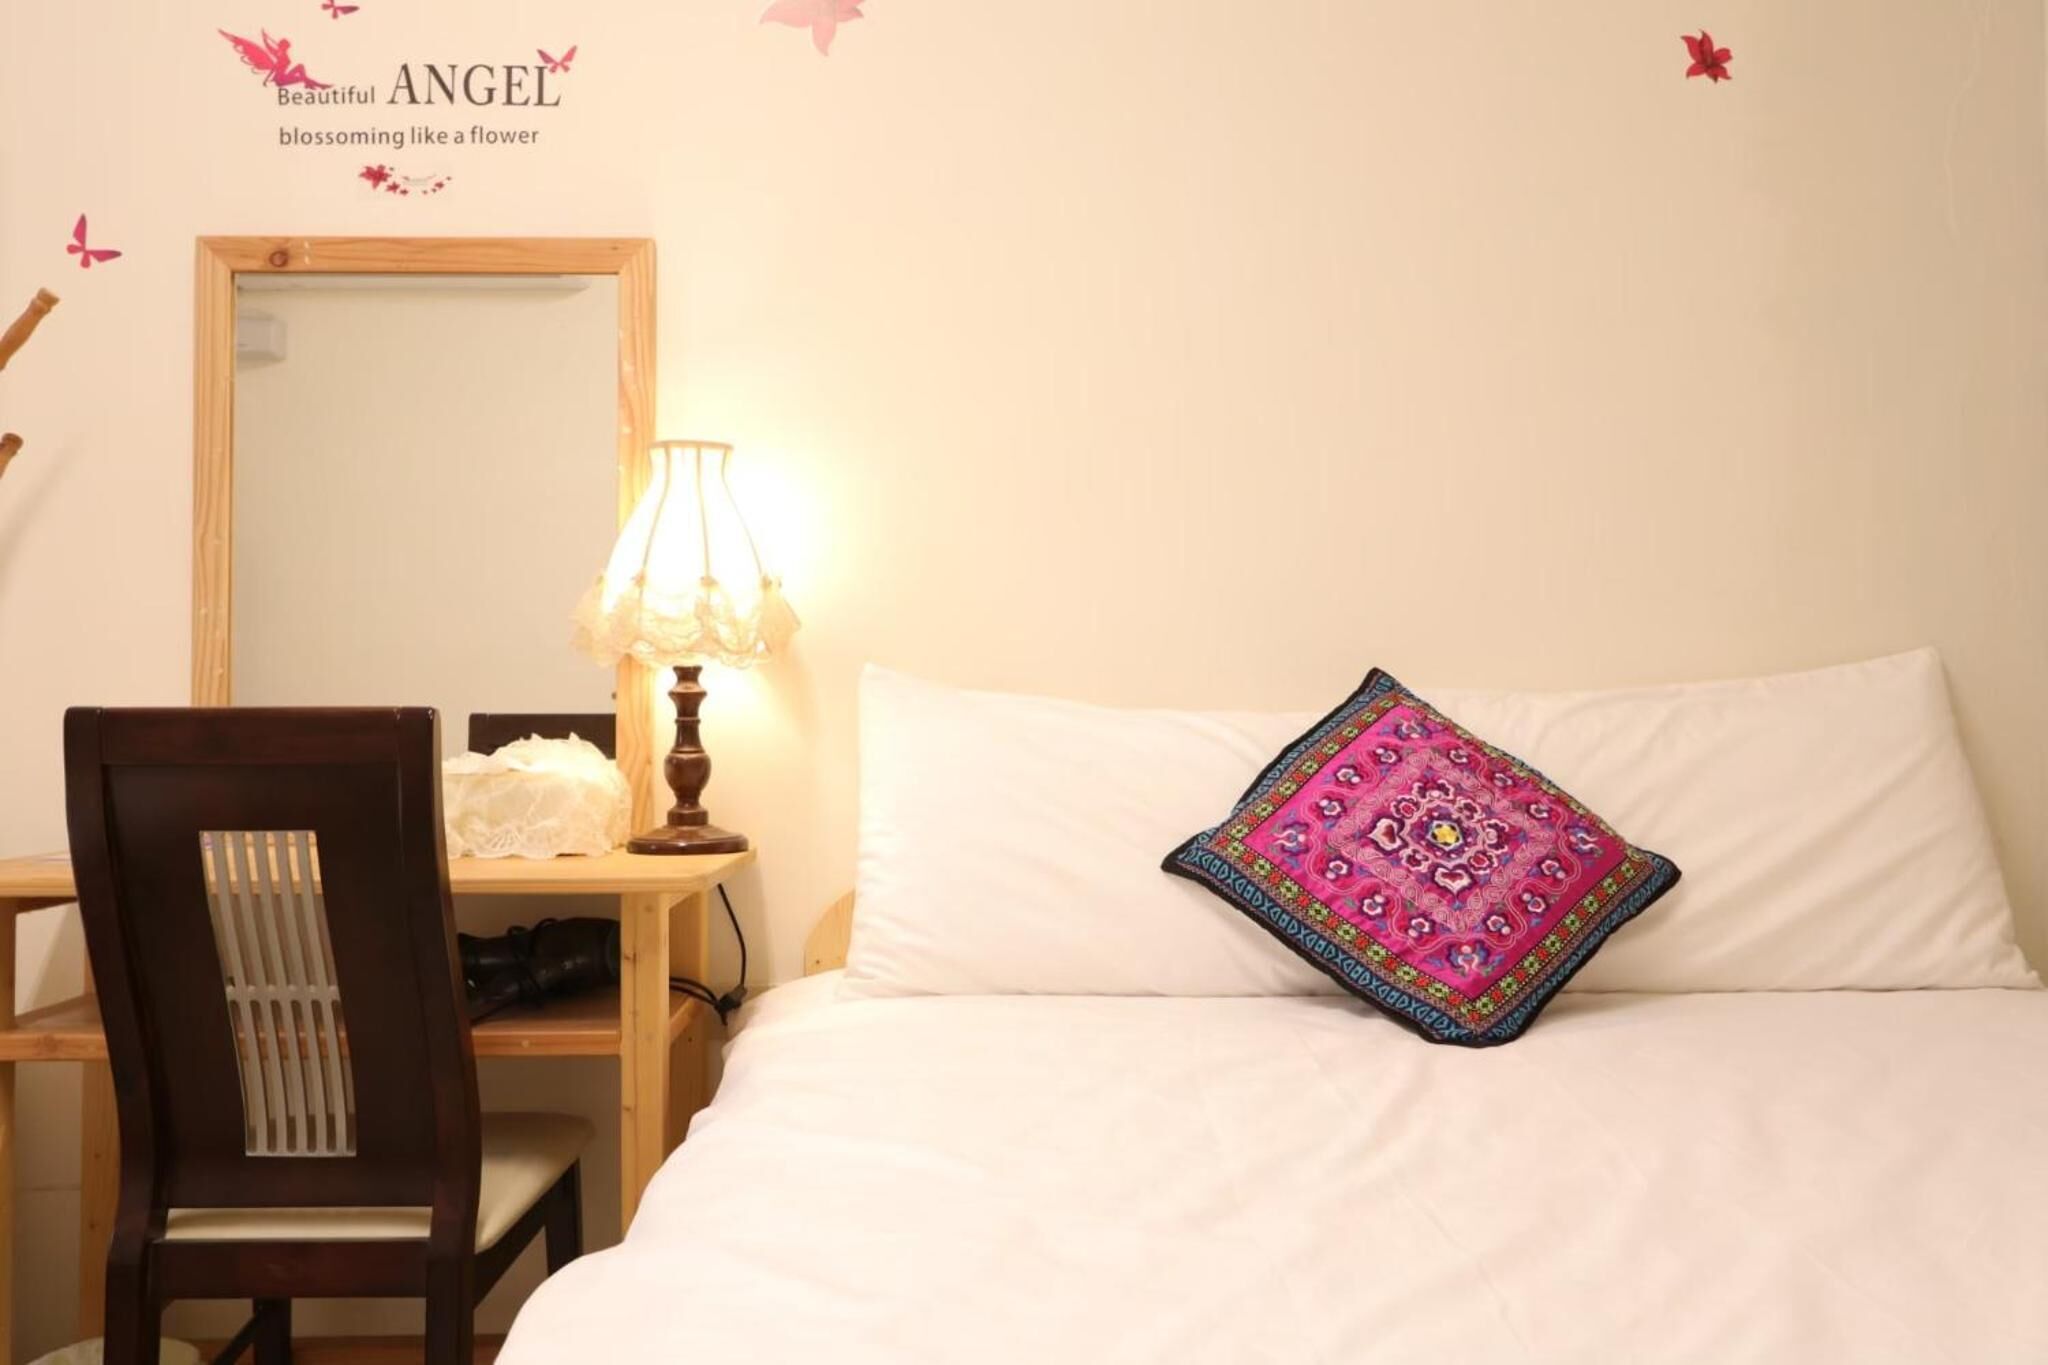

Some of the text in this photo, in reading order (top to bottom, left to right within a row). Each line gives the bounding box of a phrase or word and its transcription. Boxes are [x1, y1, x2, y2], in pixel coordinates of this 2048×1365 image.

[277, 63, 562, 107] Beautiful ANGEL
[279, 125, 539, 149] blossoming like a flower
